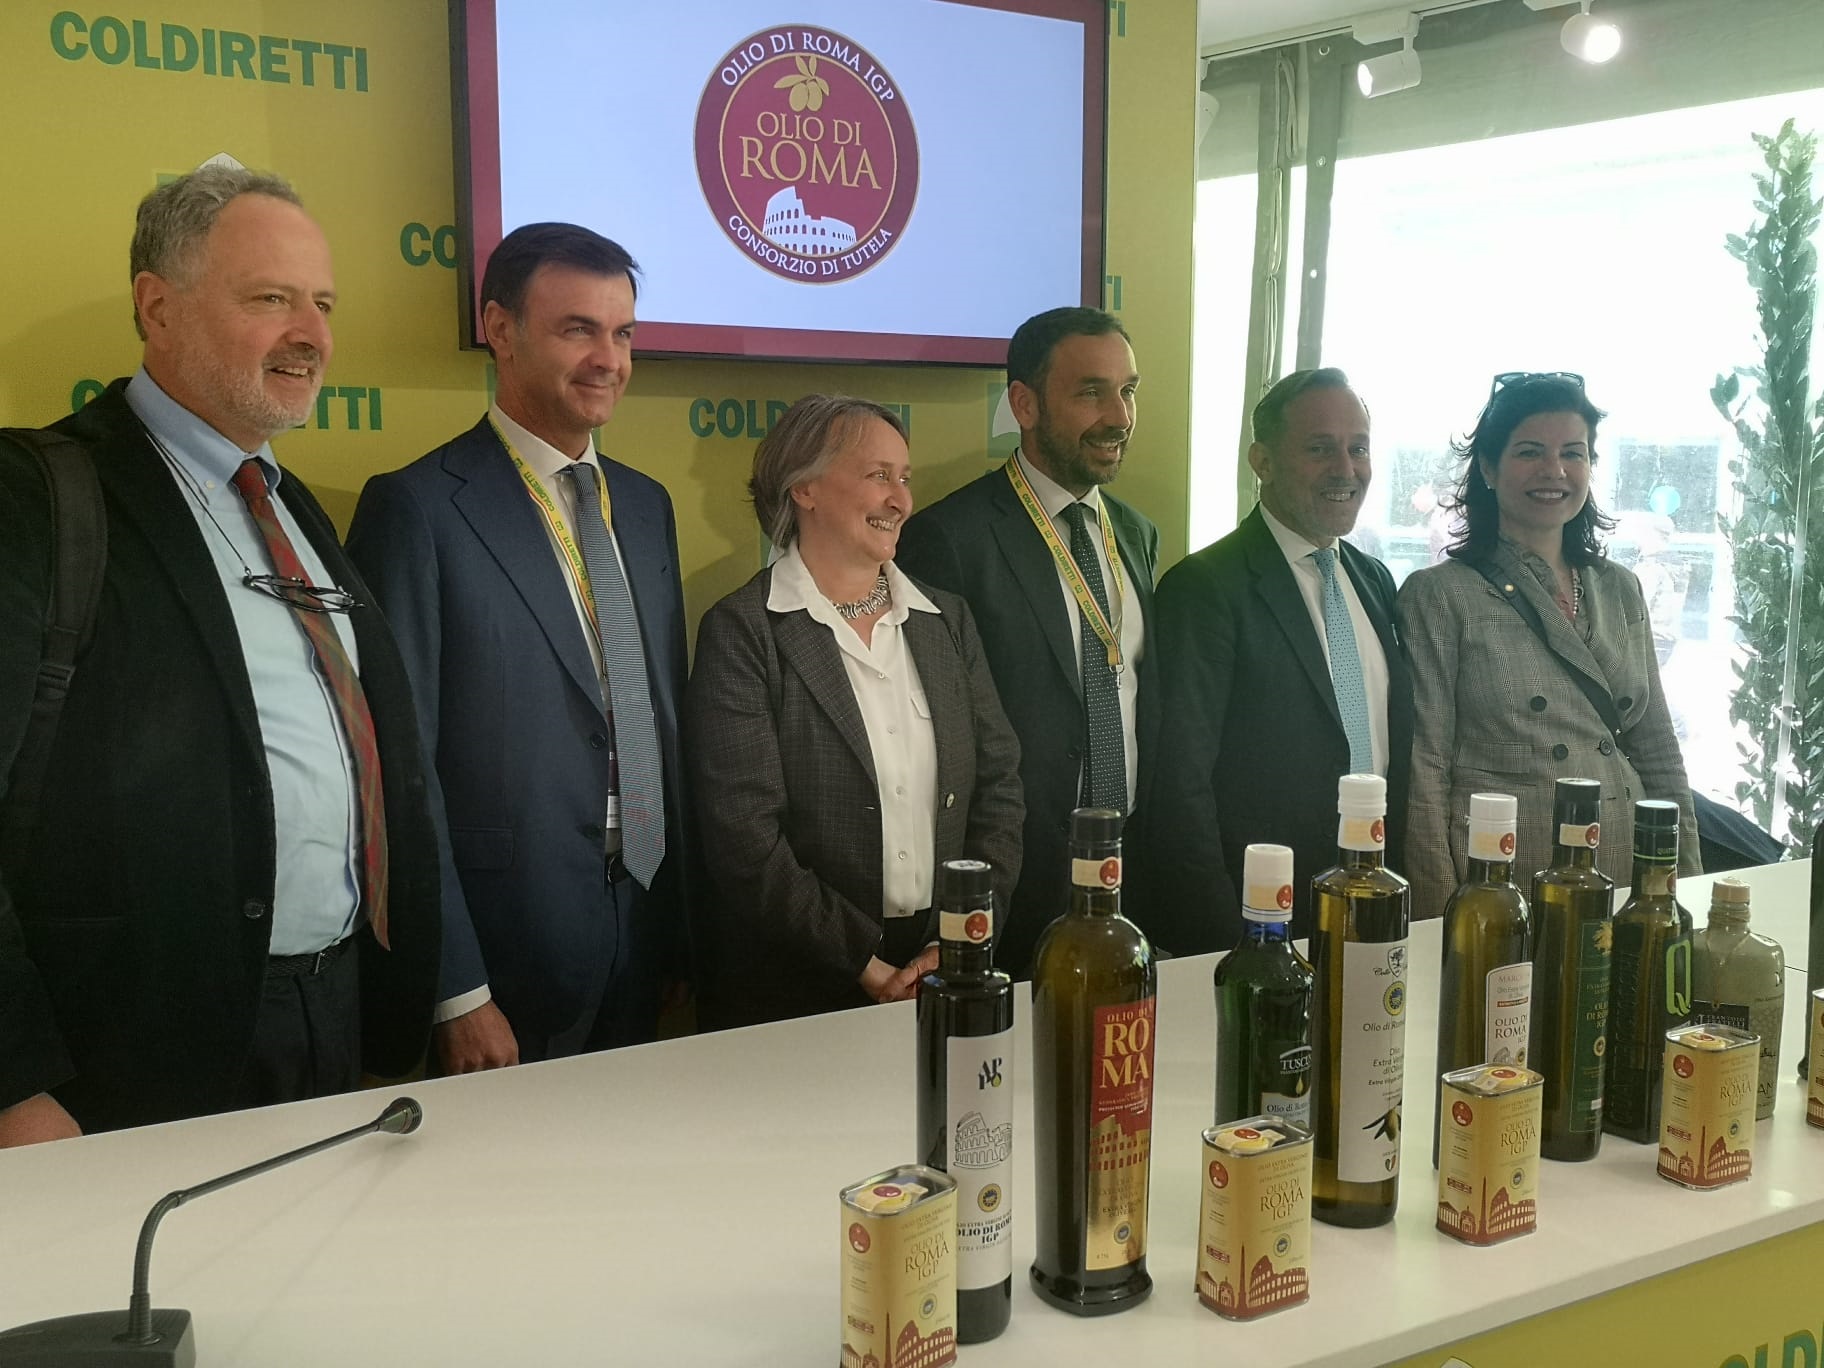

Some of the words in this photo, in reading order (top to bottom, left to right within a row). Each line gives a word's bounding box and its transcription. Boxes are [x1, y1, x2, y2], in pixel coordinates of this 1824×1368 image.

[50, 11, 368, 91] COLDIRETTI
[721, 43, 765, 86] OLIO
[770, 32, 795, 54] DI
[802, 32, 861, 73] ROMA
[864, 65, 895, 102] IGP
[757, 111, 825, 142] OLIO
[833, 118, 862, 146] DI
[739, 135, 882, 190] ROMA
[728, 215, 817, 275] CONSORZIO
[821, 259, 840, 275] DI
[841, 228, 893, 271] TUTELA
[1666, 939, 1692, 1017] Q
[1363, 1022, 1381, 1031] Olio
[1495, 1017, 1518, 1027] OLIO
[1495, 1024, 1526, 1039] ROMA
[1104, 1018, 1150, 1057] RO
[1099, 1052, 1150, 1089] MA
[1720, 1080, 1752, 1099] ROMA
[1267, 1104, 1284, 1112] Olio
[1501, 1126, 1536, 1147] ROMA
[1266, 1181, 1288, 1194] OLIO
[1260, 1186, 1304, 1212] ROMA
[1273, 1203, 1293, 1220] IGP
[982, 1220, 993, 1235] DI
[911, 1236, 934, 1253] OLIO
[982, 1233, 999, 1244] IGP
[905, 1240, 949, 1273] ROMA
[917, 1259, 939, 1281] IGP
